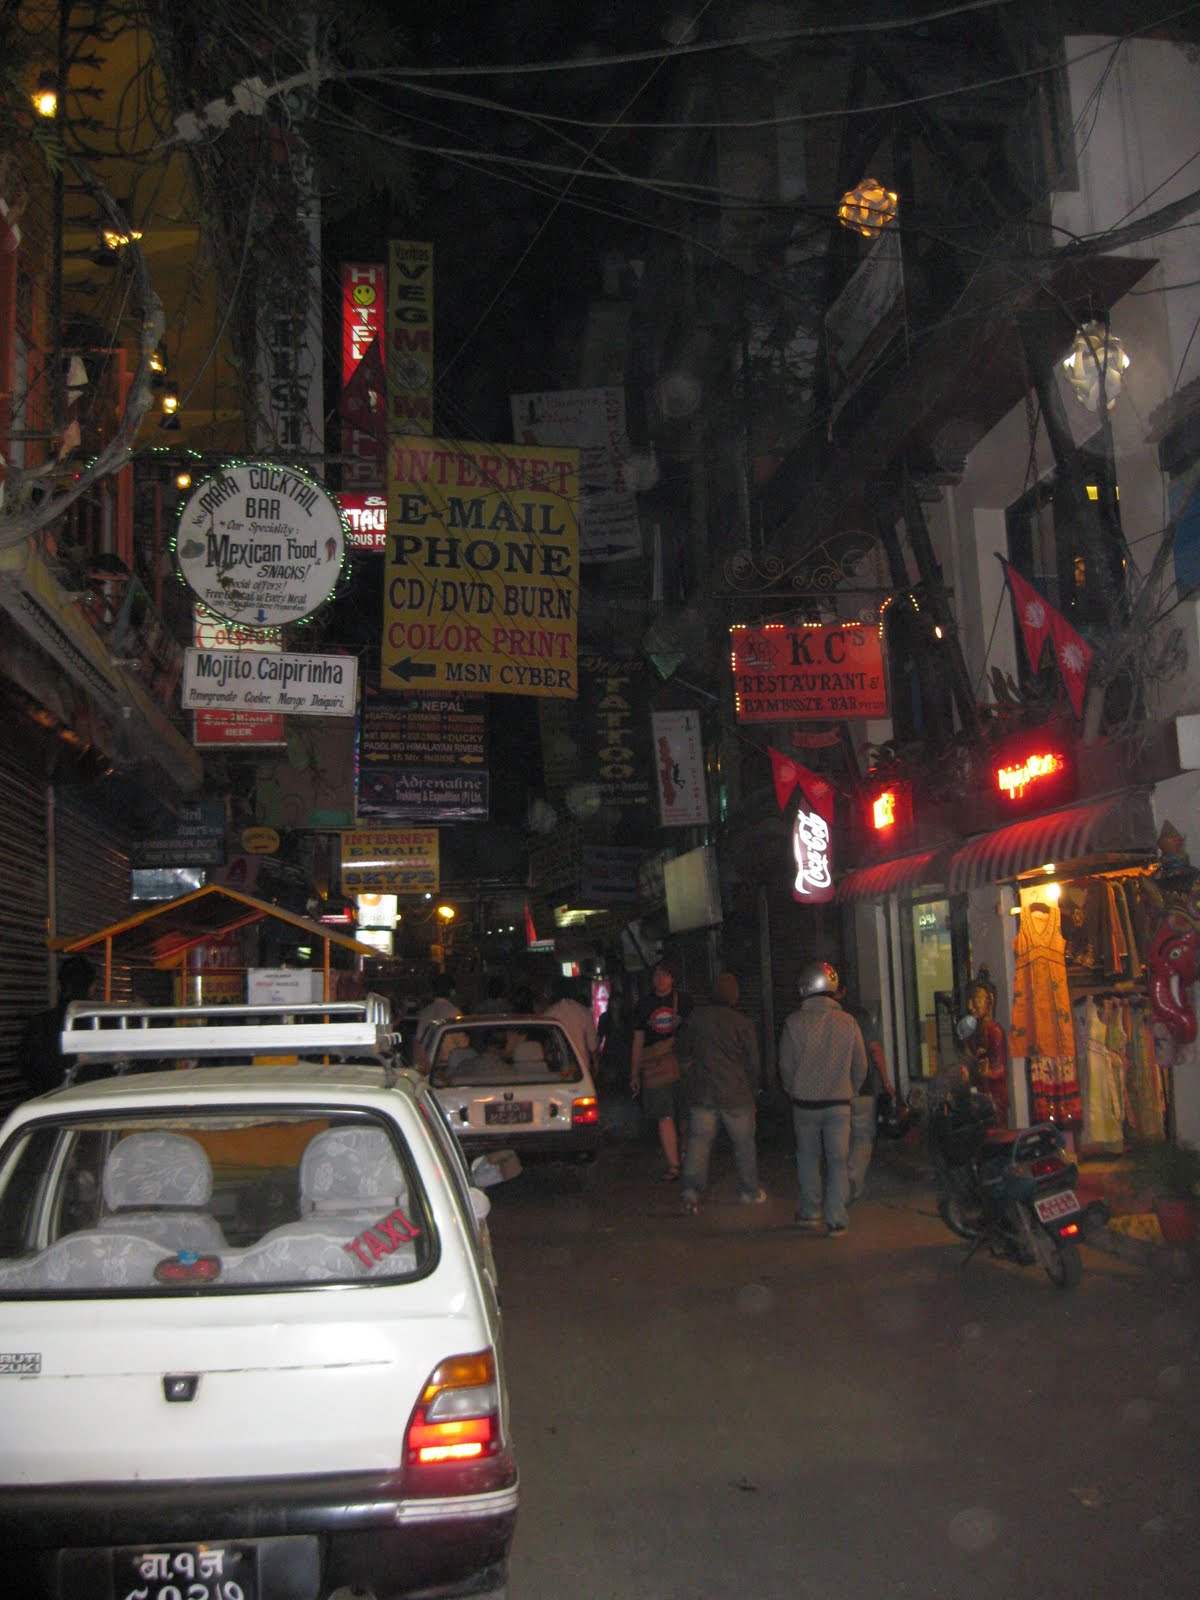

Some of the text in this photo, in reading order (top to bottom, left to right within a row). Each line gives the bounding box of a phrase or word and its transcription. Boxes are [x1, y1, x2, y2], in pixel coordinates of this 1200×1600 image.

[393, 448, 573, 495] INTERNET
[199, 475, 241, 516] MAYA
[249, 468, 319, 518] COCKTAIL
[246, 497, 281, 520] BAR
[345, 508, 387, 532] TAU
[397, 493, 567, 536] E-MAIL
[227, 519, 245, 531] Our
[205, 534, 282, 569] Mexican
[286, 537, 317, 560] Food
[390, 534, 572, 577] PHONE
[224, 578, 252, 593] pecial
[388, 577, 572, 620] CD/DVD BURN
[388, 622, 573, 660] COLOR PRINT
[257, 656, 344, 690] Caipirinha
[445, 662, 572, 689] MSN CYBER
[739, 671, 868, 694] RESTAURANT
[421, 700, 464, 713] NEPAL
[826, 695, 858, 712] BAR
[225, 728, 253, 738] BEER
[593, 677, 635, 781] TATTOO
[454, 744, 485, 753] RIVERS
[344, 832, 434, 846] INTERNET
[350, 846, 431, 857] E-MAIL
[793, 808, 832, 895] Coca-Cola
[345, 870, 437, 885] SKYPE
[343, 1209, 421, 1269] TAXI
